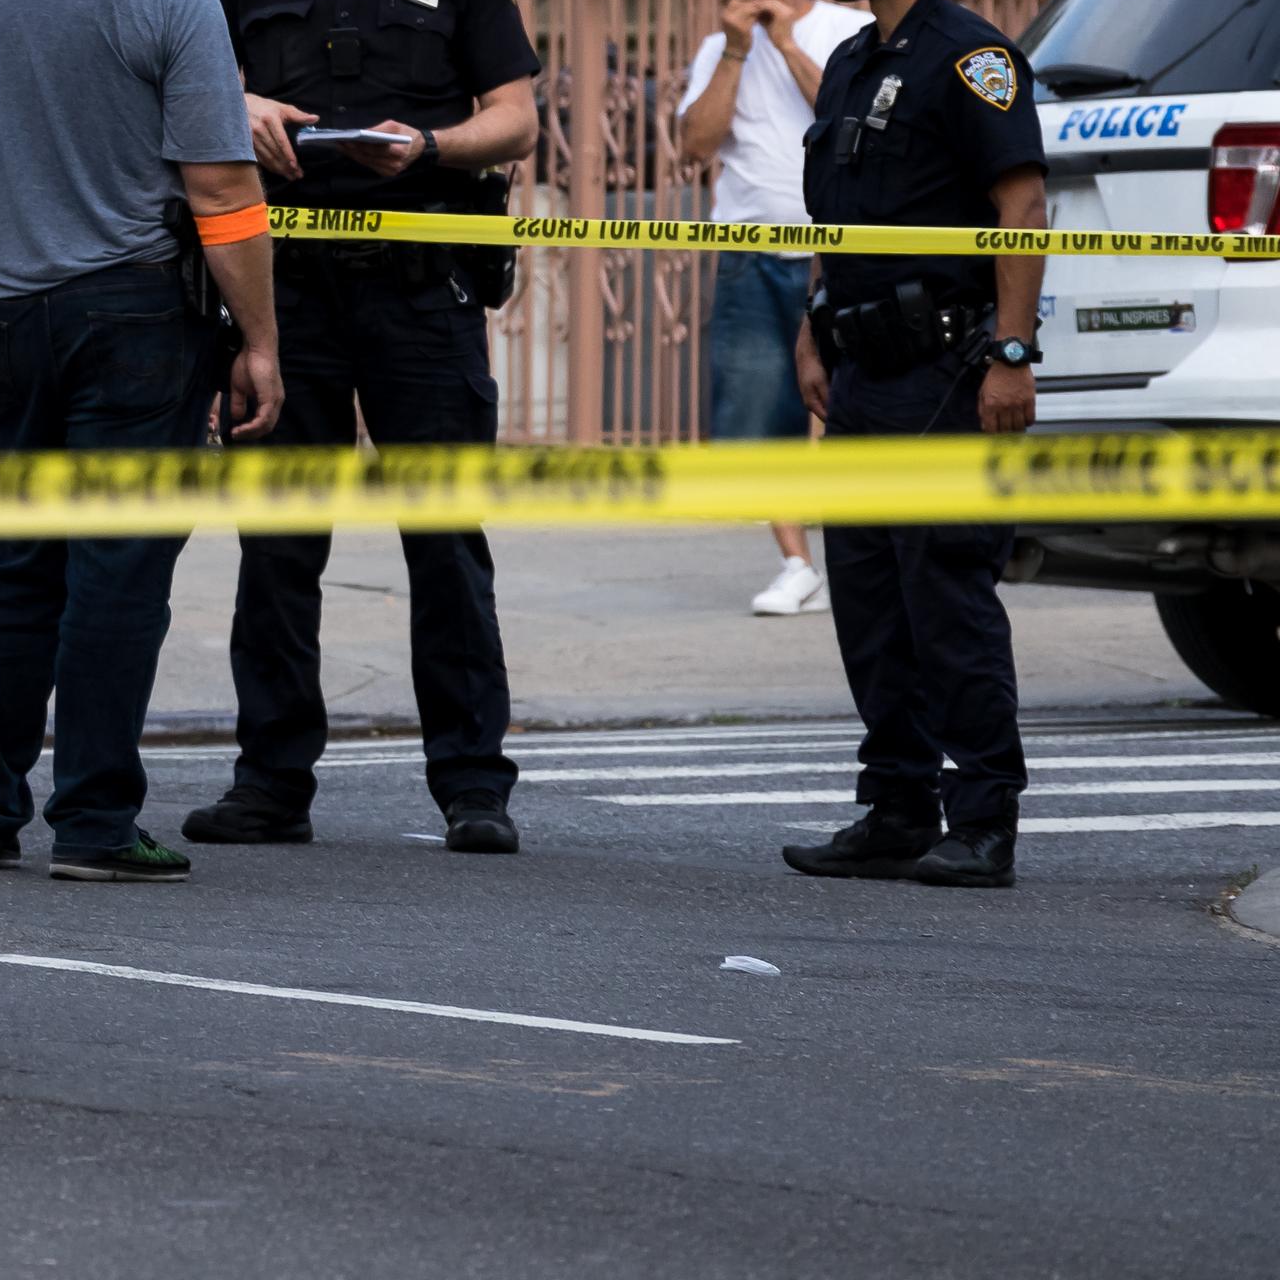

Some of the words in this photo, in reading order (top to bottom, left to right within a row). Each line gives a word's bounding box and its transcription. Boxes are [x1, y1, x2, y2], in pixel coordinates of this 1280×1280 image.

[1058, 104, 1189, 141] POLICE
[1122, 309, 1171, 325] INSPIRES
[1189, 436, 1280, 497] SCE
